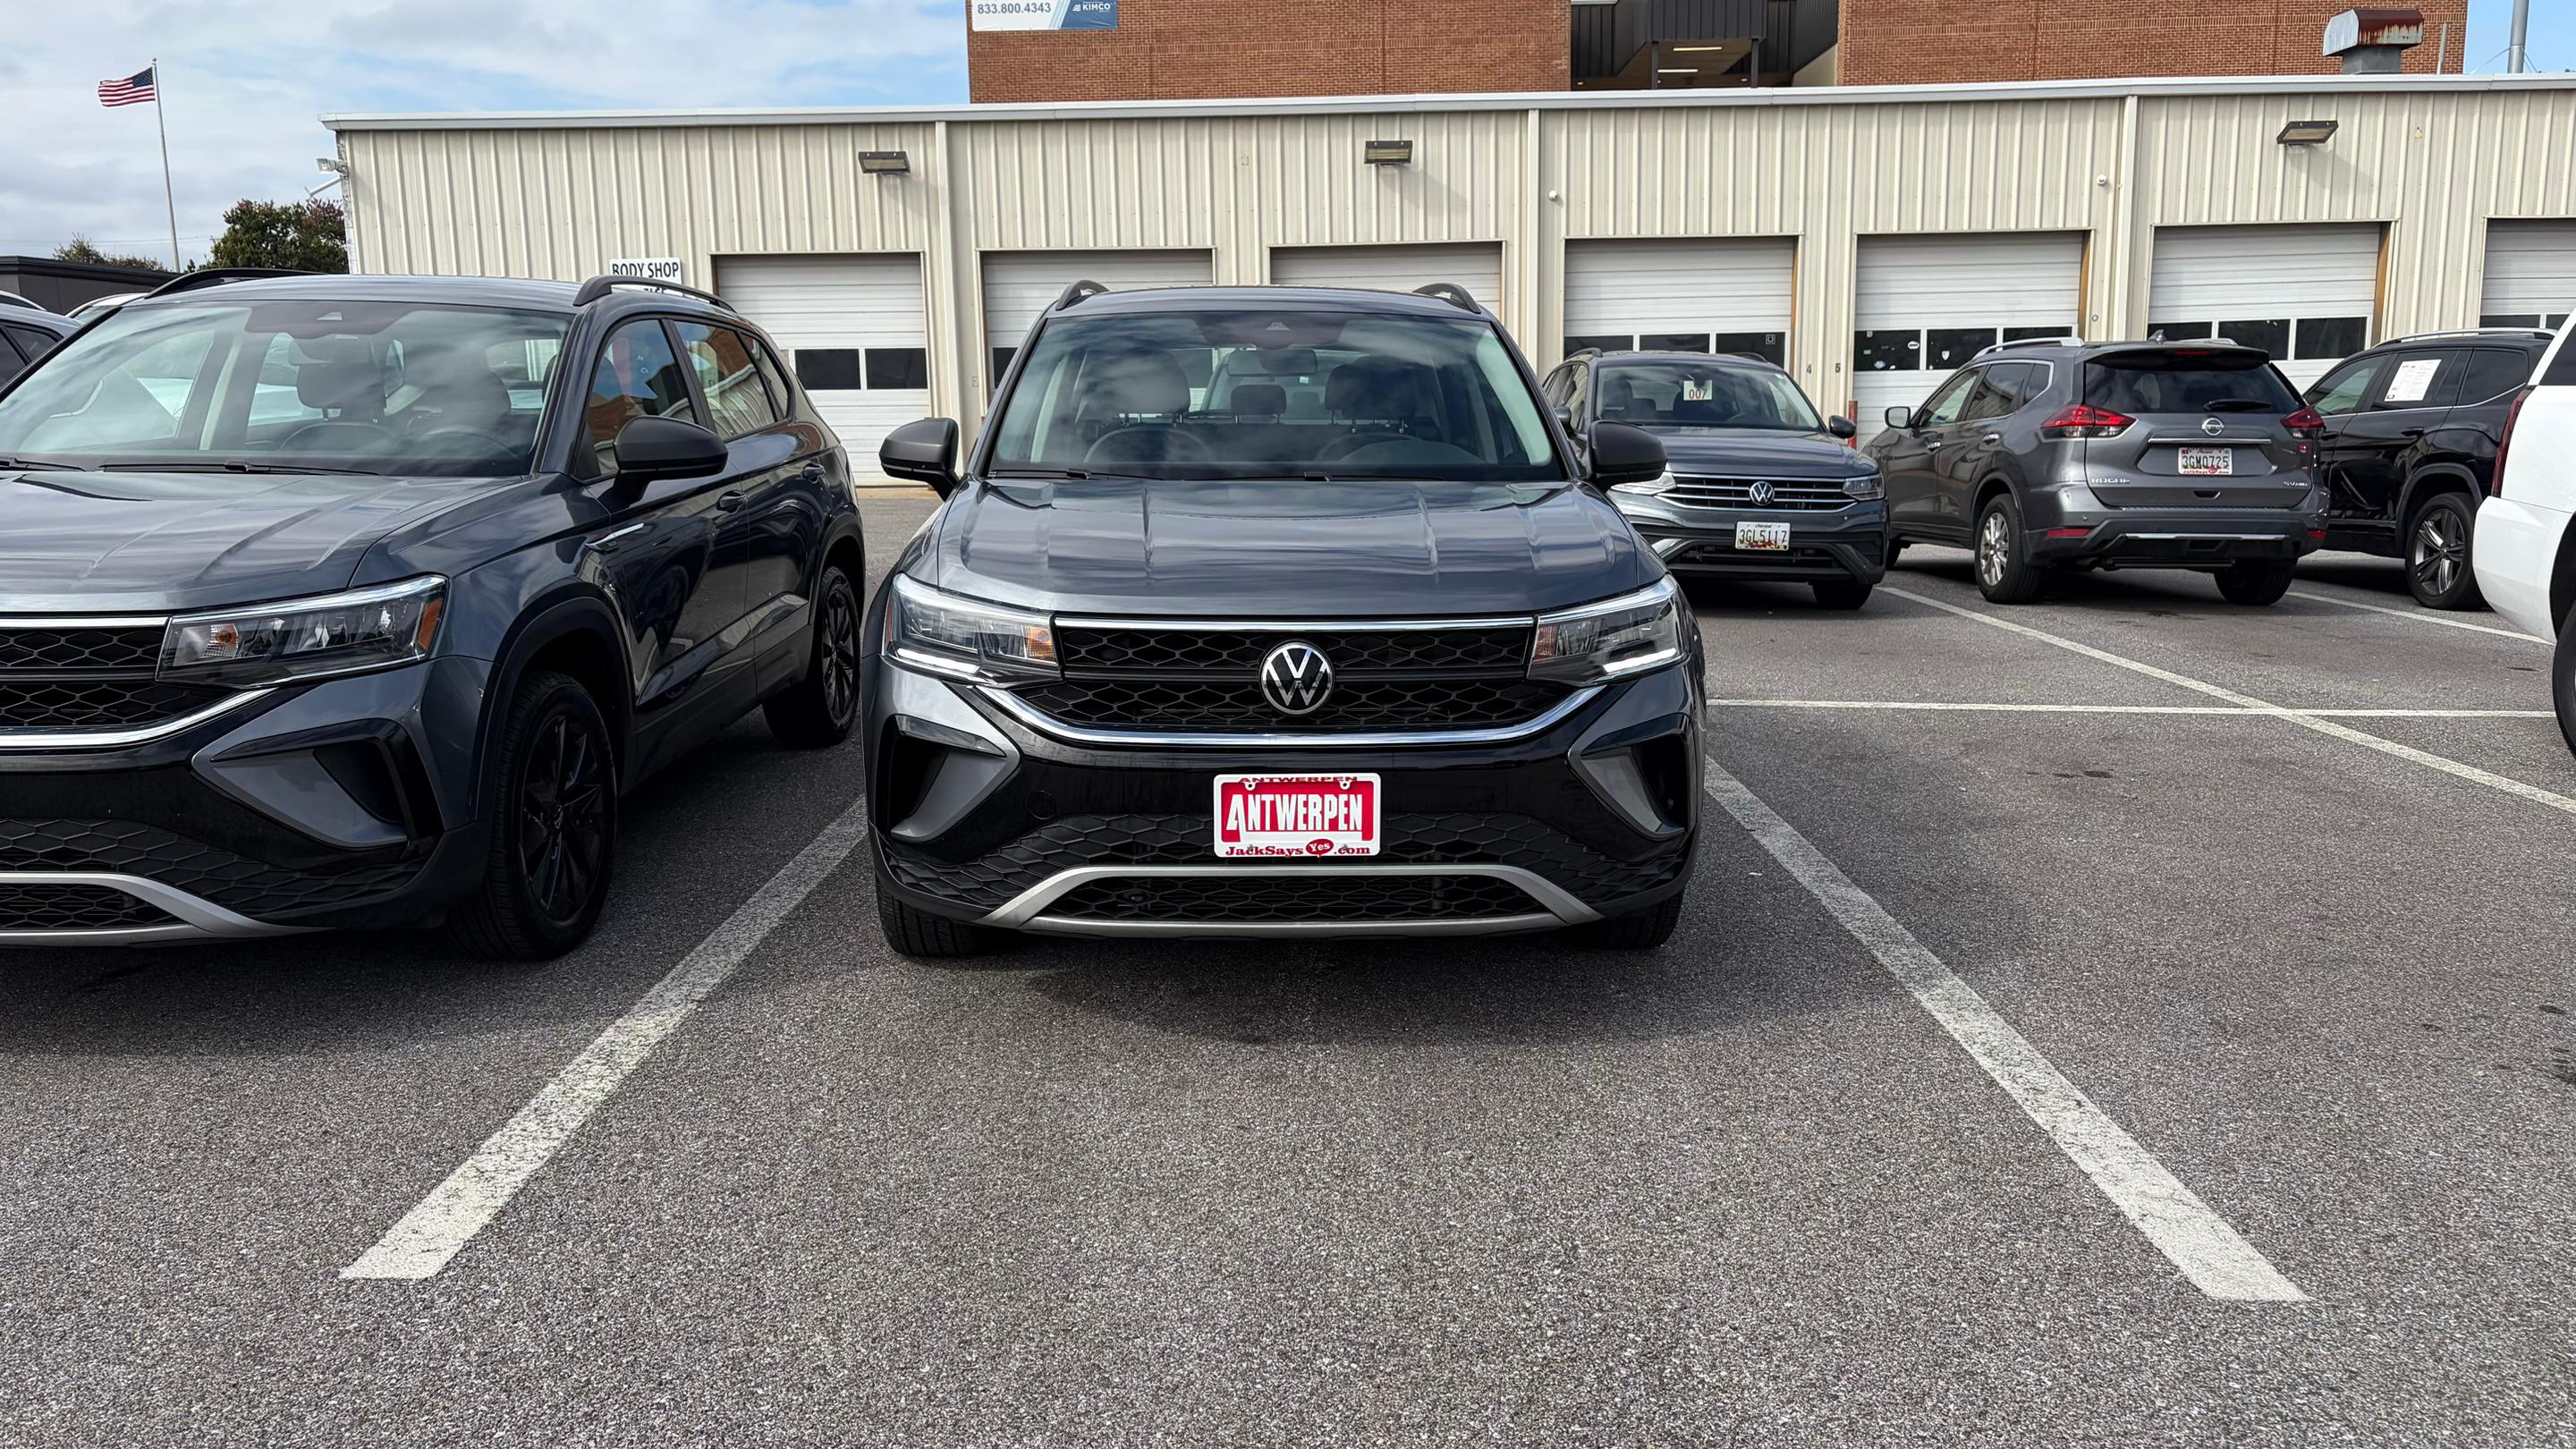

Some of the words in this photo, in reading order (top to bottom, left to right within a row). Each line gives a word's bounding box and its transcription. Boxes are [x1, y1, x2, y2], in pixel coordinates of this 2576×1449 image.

[977, 3, 1051, 14] 833.800.4343
[612, 262, 645, 277] BODY
[647, 261, 679, 278] SHOP
[1835, 362, 1842, 374] 5
[1689, 387, 1707, 400] 007
[1239, 775, 1358, 784] ANTWERPEN
[1226, 793, 1362, 832] ANTWERPEN
